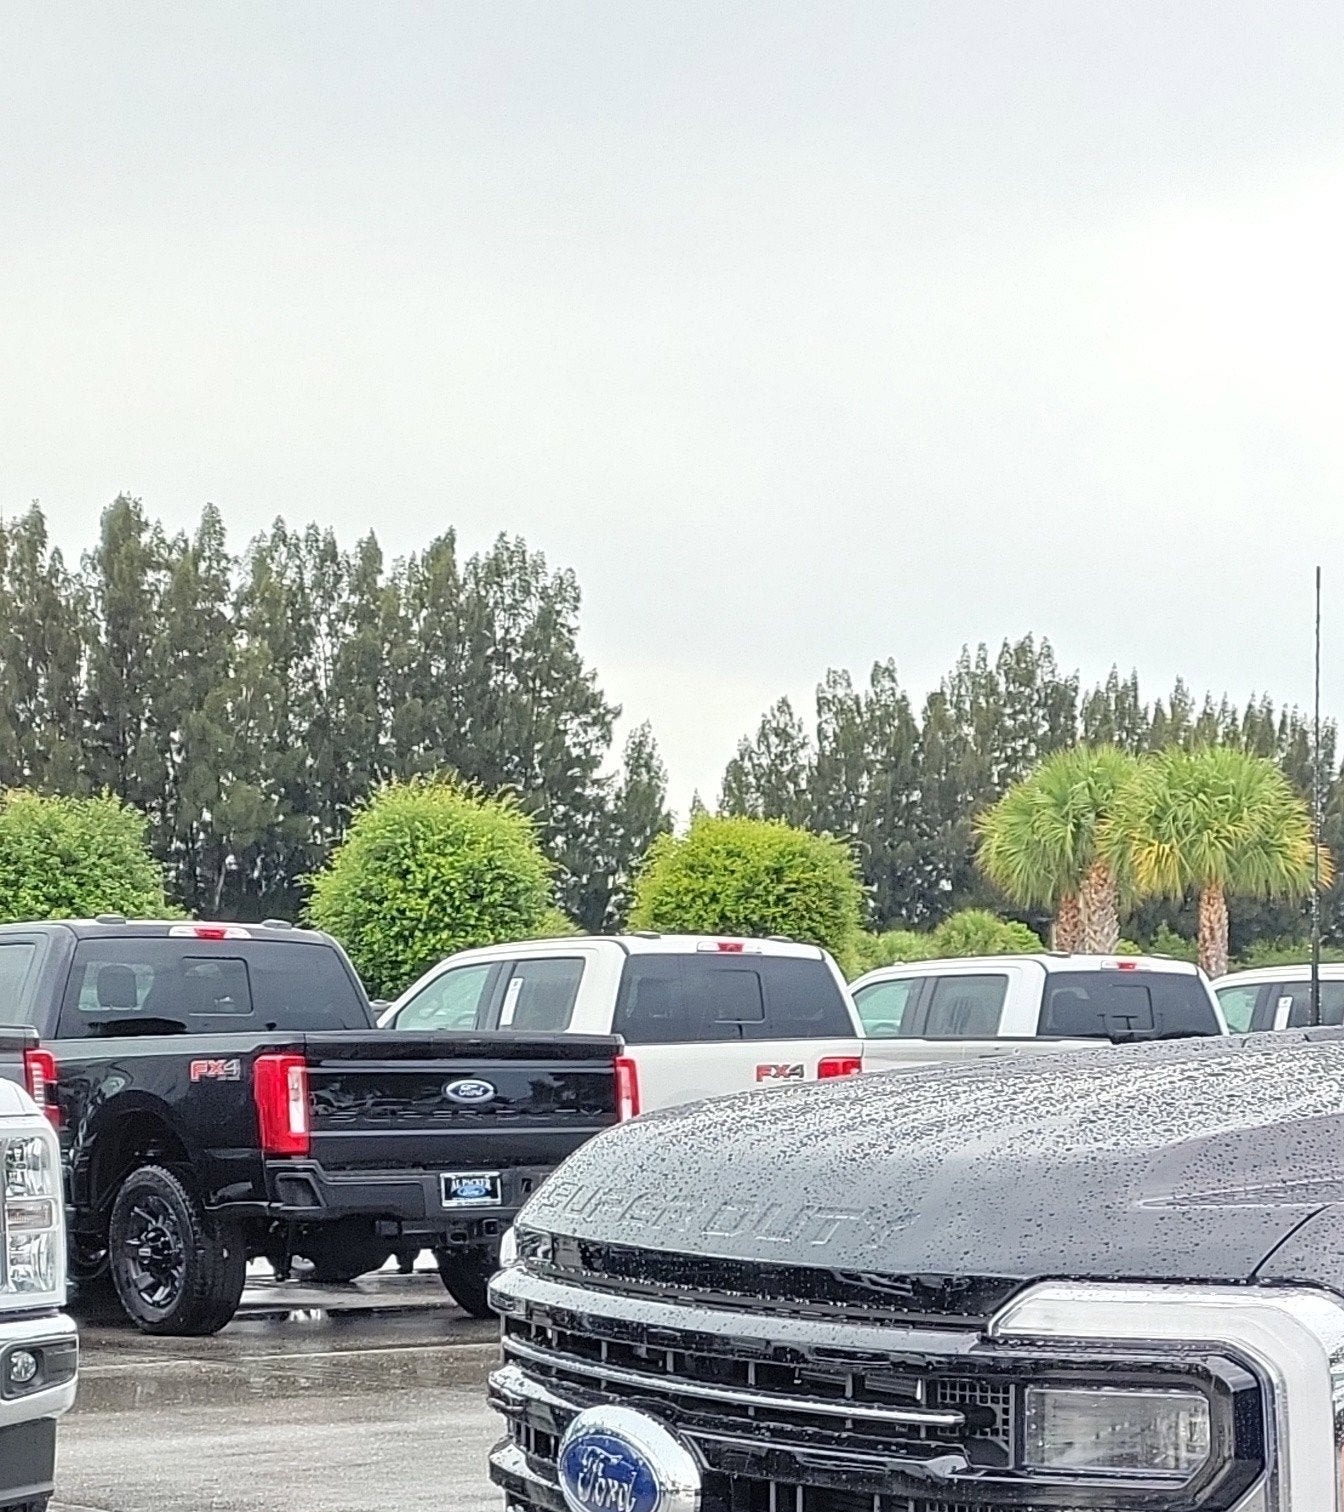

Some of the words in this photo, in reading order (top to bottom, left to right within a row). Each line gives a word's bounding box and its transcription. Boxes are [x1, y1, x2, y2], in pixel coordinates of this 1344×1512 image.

[190, 1059, 241, 1082] FX4
[756, 1064, 805, 1082] FX4
[700, 1199, 922, 1250] DUTY
